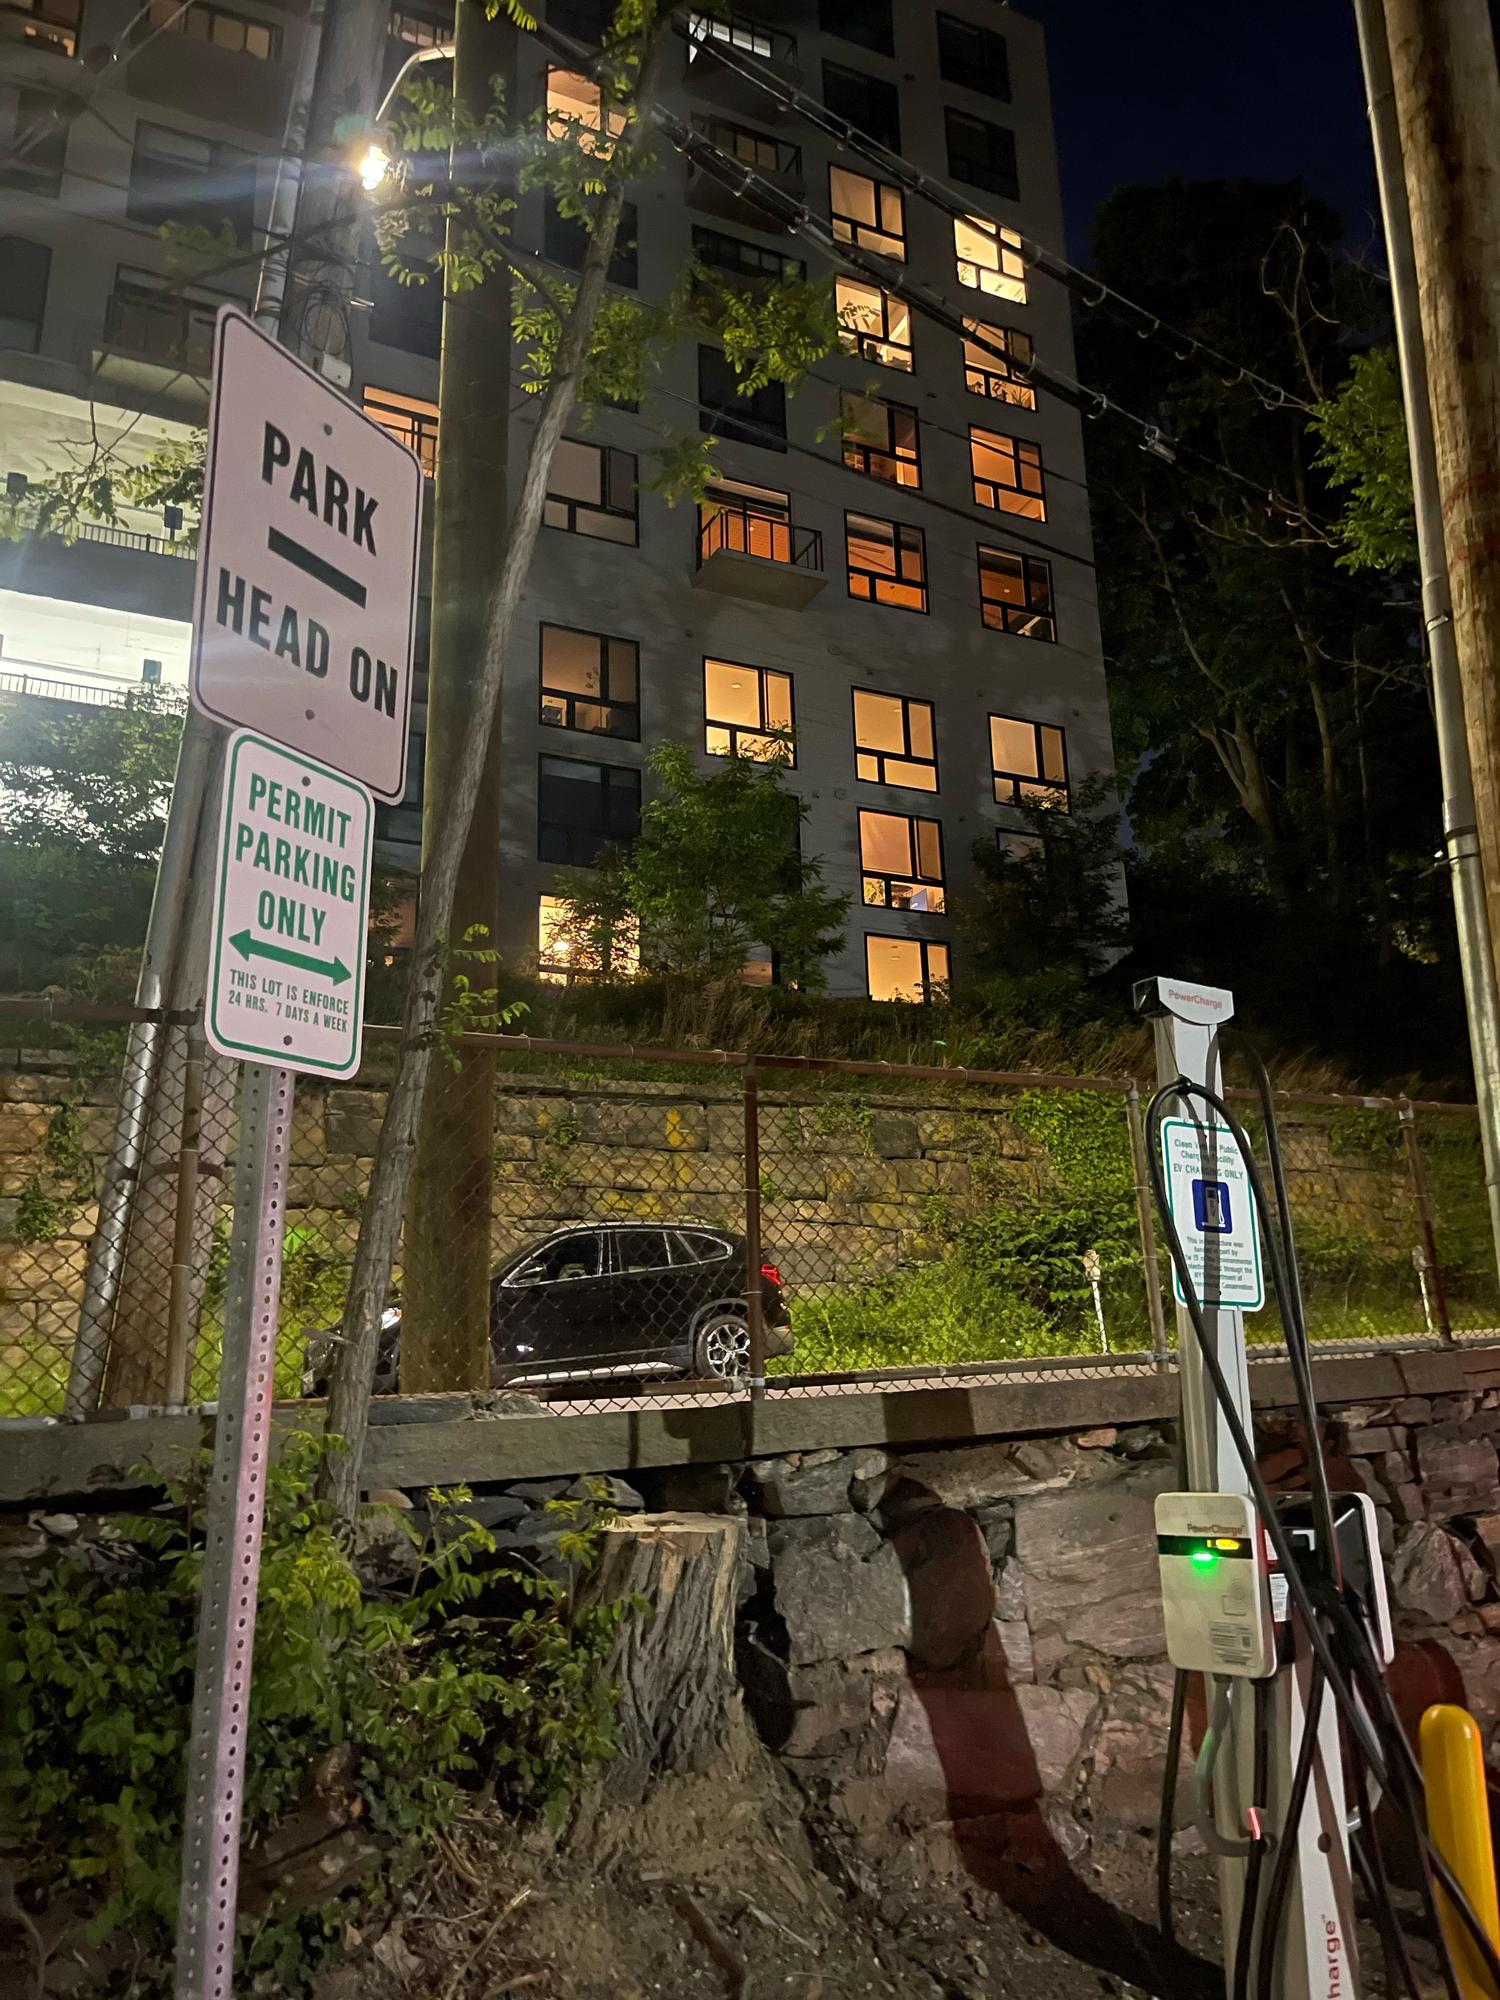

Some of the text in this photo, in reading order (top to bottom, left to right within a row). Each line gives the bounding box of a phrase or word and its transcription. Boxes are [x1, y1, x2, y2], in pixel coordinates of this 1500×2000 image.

[261, 420, 379, 557] PARK
[216, 566, 398, 720] HEAD ON
[249, 772, 352, 849] PERMIT
[235, 822, 356, 903] PARKING
[258, 889, 327, 946] ONLY
[228, 990, 348, 1033] 24 HRS. 7 DAYS A WEEK
[230, 968, 350, 1015] THIS LOT IS ENFORCE
[1168, 989, 1222, 1009] PowerCharge
[1173, 1163, 1182, 1173] EV
[1224, 1169, 1244, 1180] ONLY
